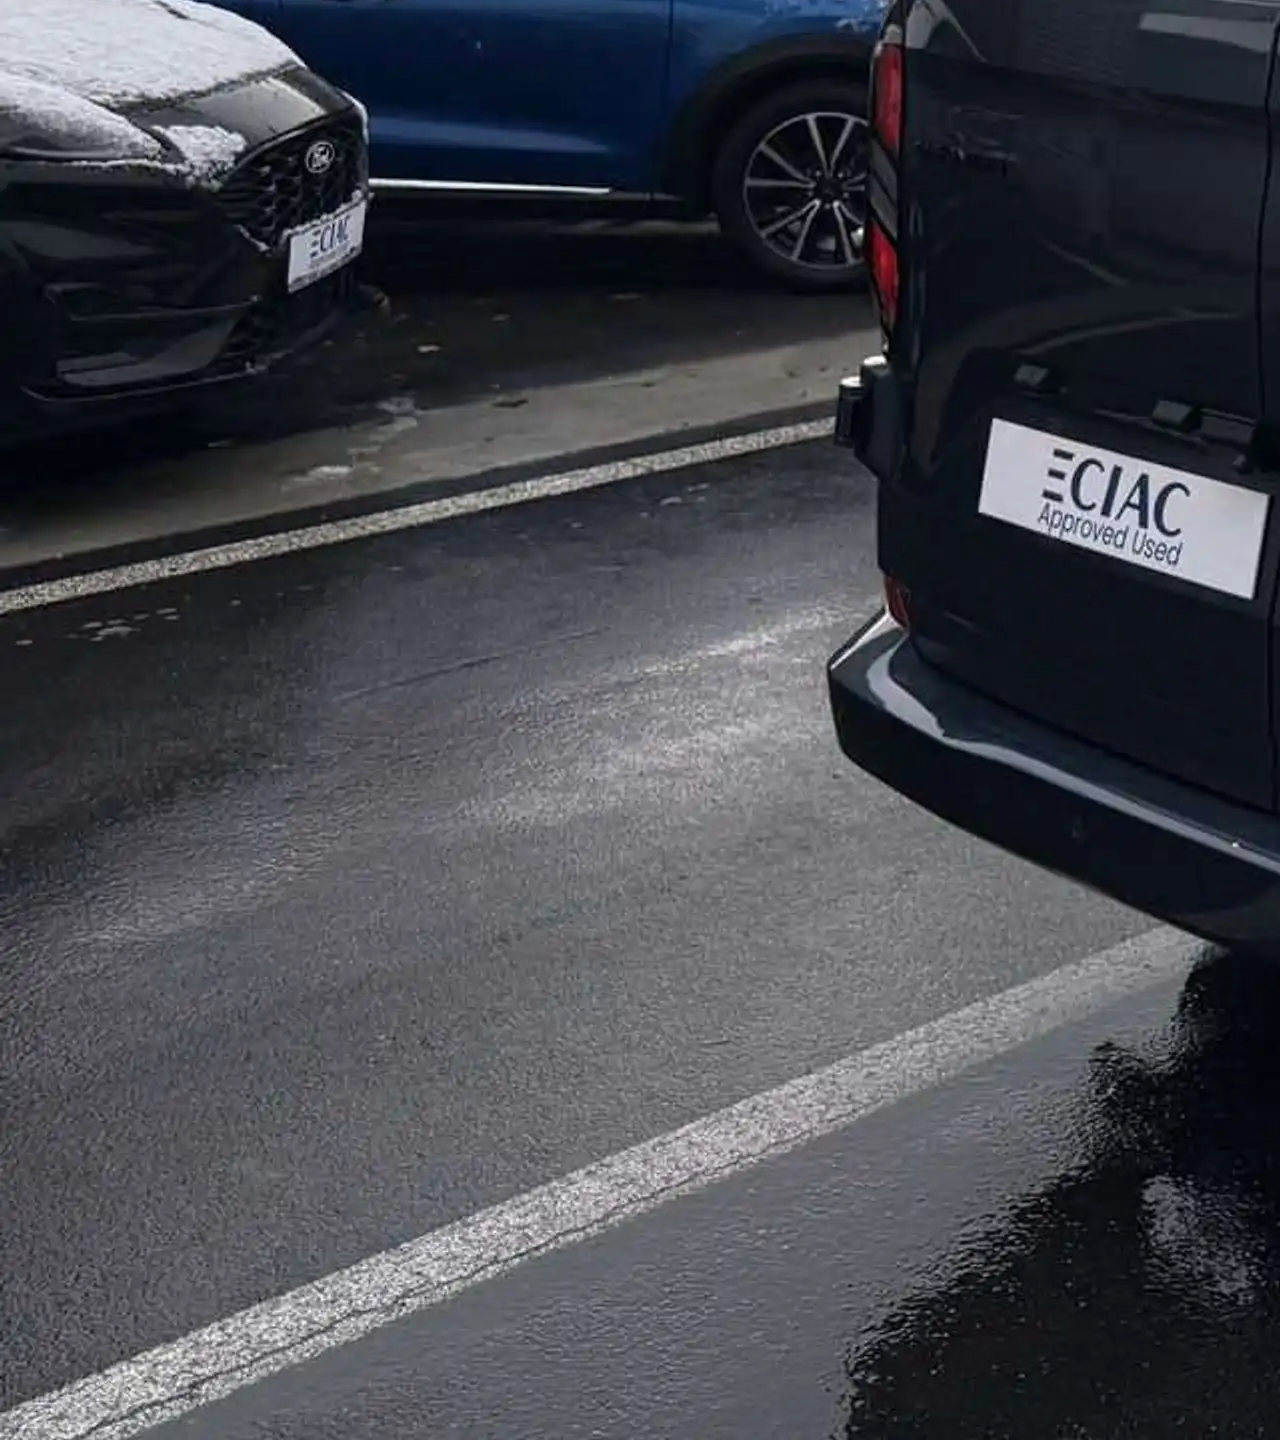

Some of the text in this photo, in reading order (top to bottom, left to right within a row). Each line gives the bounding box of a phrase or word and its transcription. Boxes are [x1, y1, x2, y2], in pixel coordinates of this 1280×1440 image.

[1042, 448, 1191, 538] ECIAC
[1038, 502, 1184, 566] Approved Used
